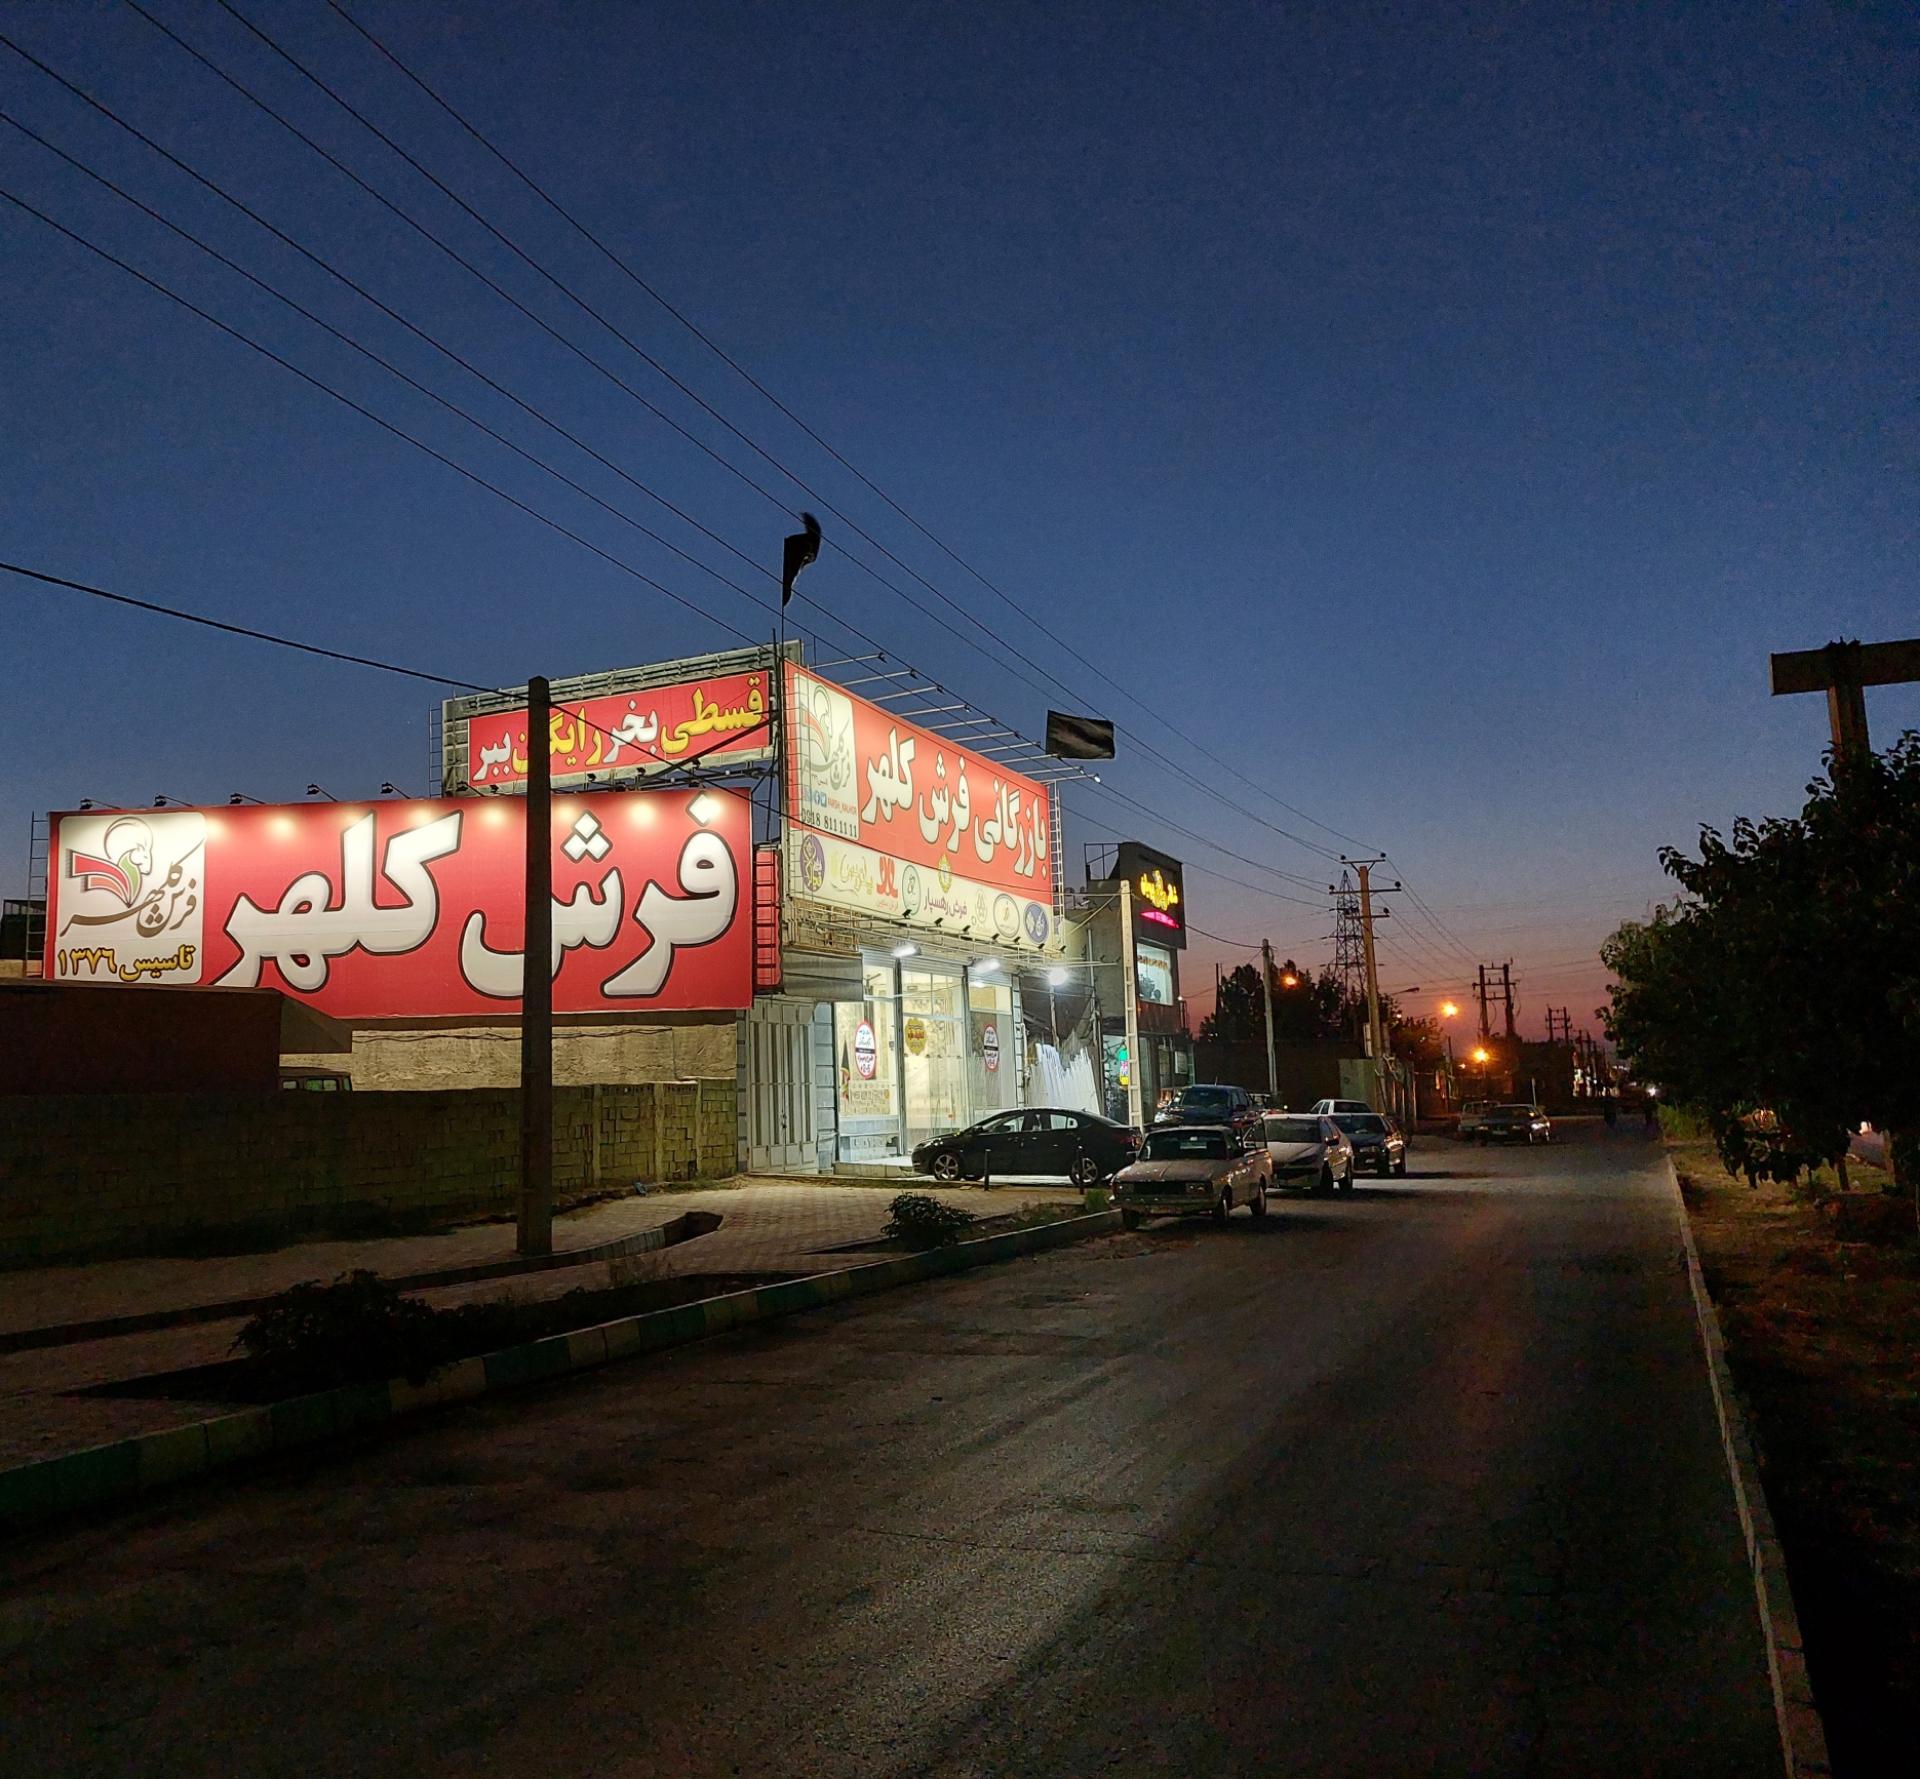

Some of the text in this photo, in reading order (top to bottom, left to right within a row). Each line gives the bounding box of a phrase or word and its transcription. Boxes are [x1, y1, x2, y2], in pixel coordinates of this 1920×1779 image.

[472, 675, 763, 781] قسطی بخر رایگن ببر
[861, 726, 916, 824] کلهر
[824, 816, 838, 831] 811
[839, 821, 847, 834] 11
[849, 824, 857, 838] 11
[918, 754, 971, 854] فرش
[974, 776, 1047, 880] بازرگانی
[209, 792, 738, 999] فرش کلهر
[119, 943, 196, 982] تاسیس
